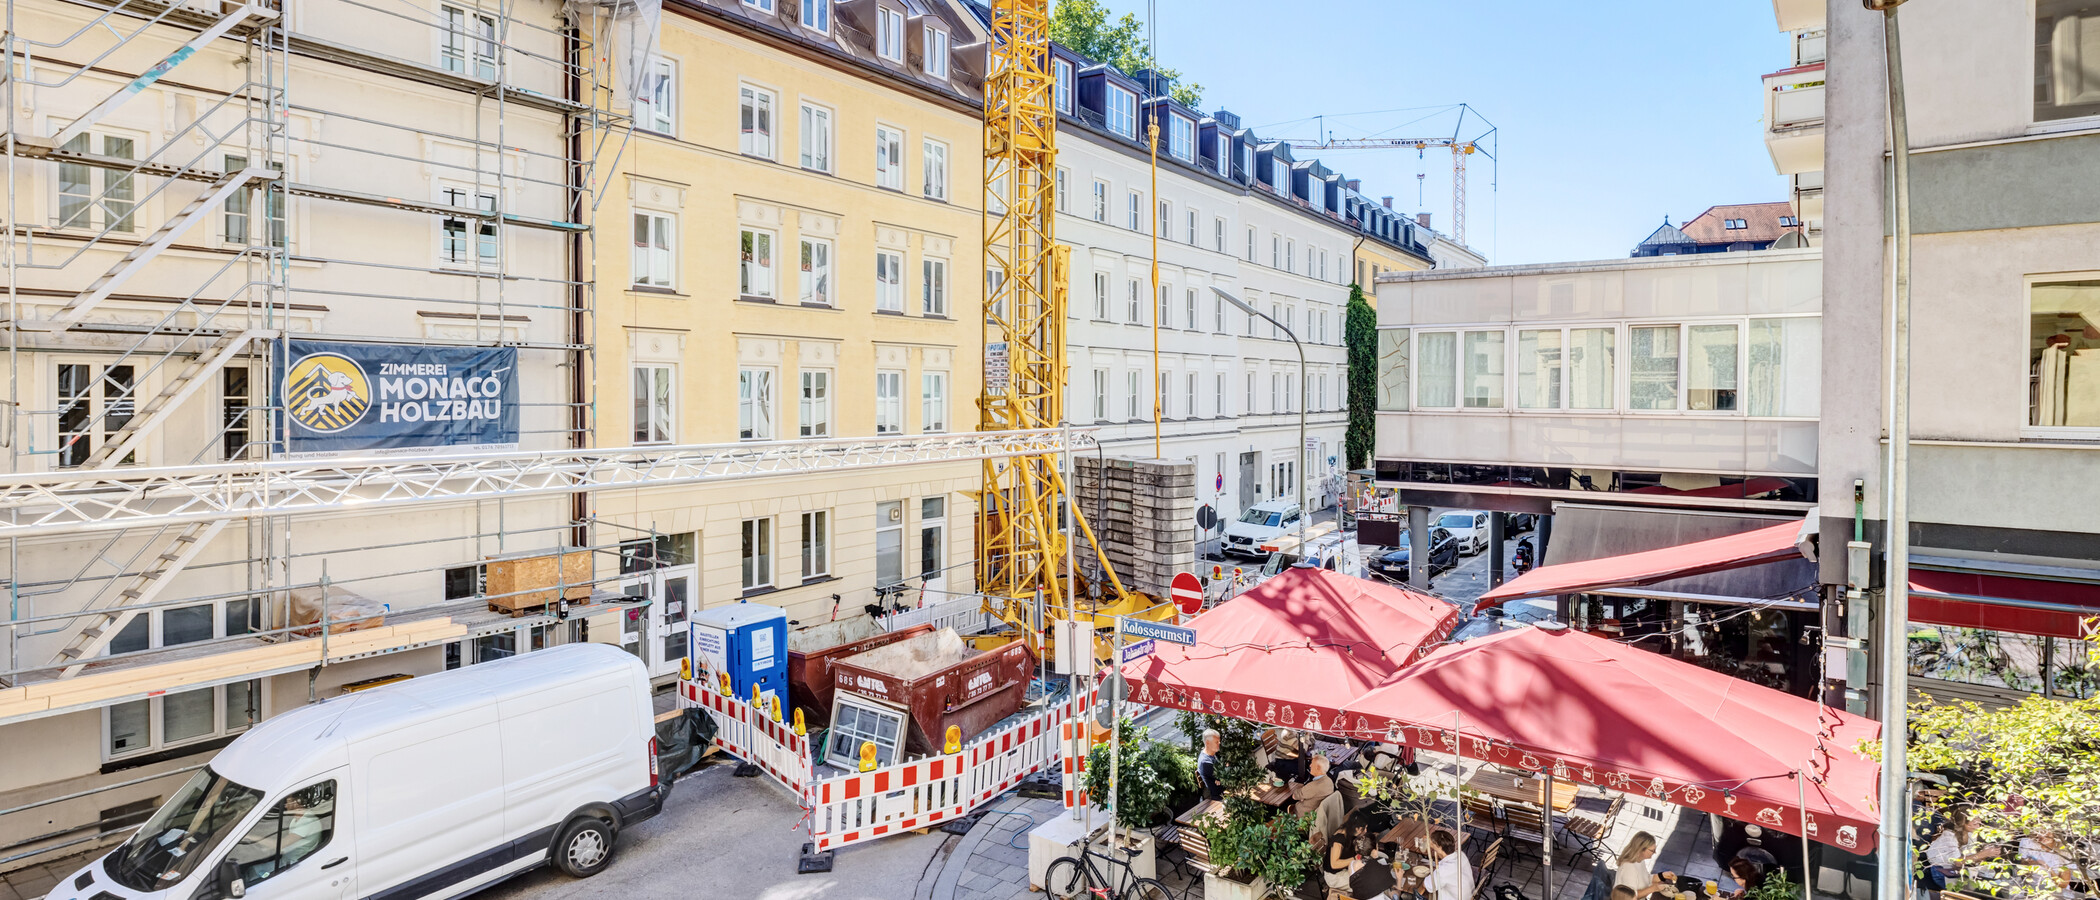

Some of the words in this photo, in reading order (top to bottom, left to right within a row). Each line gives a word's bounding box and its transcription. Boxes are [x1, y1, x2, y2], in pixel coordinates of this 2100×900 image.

[379, 363, 447, 376] ZIMMEREI
[379, 376, 501, 400] MONACO
[379, 400, 501, 423] HOLZBAU
[622, 549, 636, 568] 7
[1122, 620, 1192, 645] Kolosseumstr.
[838, 674, 853, 686] 685
